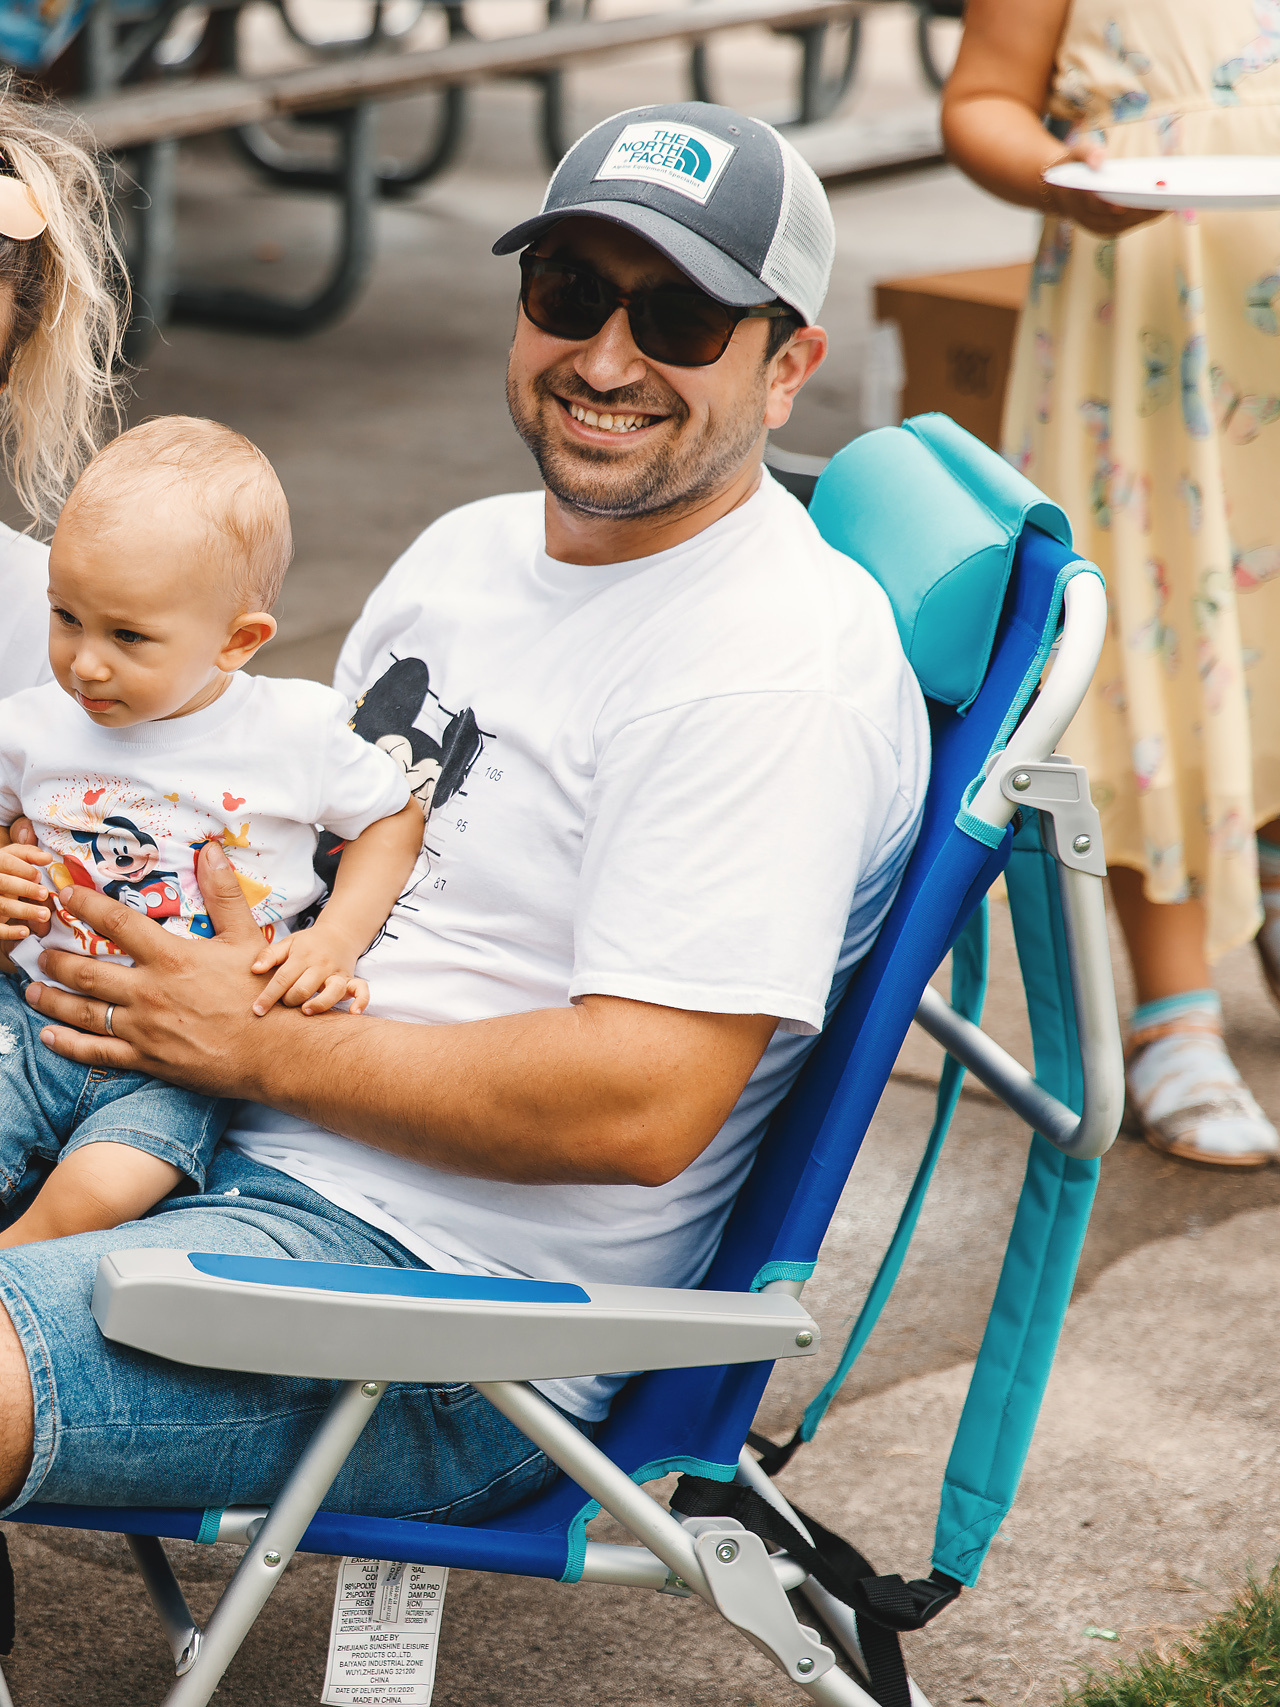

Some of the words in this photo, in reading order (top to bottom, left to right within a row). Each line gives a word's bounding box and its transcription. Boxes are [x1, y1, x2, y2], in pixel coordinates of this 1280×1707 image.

[654, 130, 688, 146] THE
[618, 141, 683, 157] NORTH
[629, 152, 676, 168] FACE
[633, 164, 668, 174] Equipment
[669, 171, 700, 188] Specialist
[485, 767, 504, 782] 105
[455, 819, 468, 833] 95
[433, 877, 446, 891] 87
